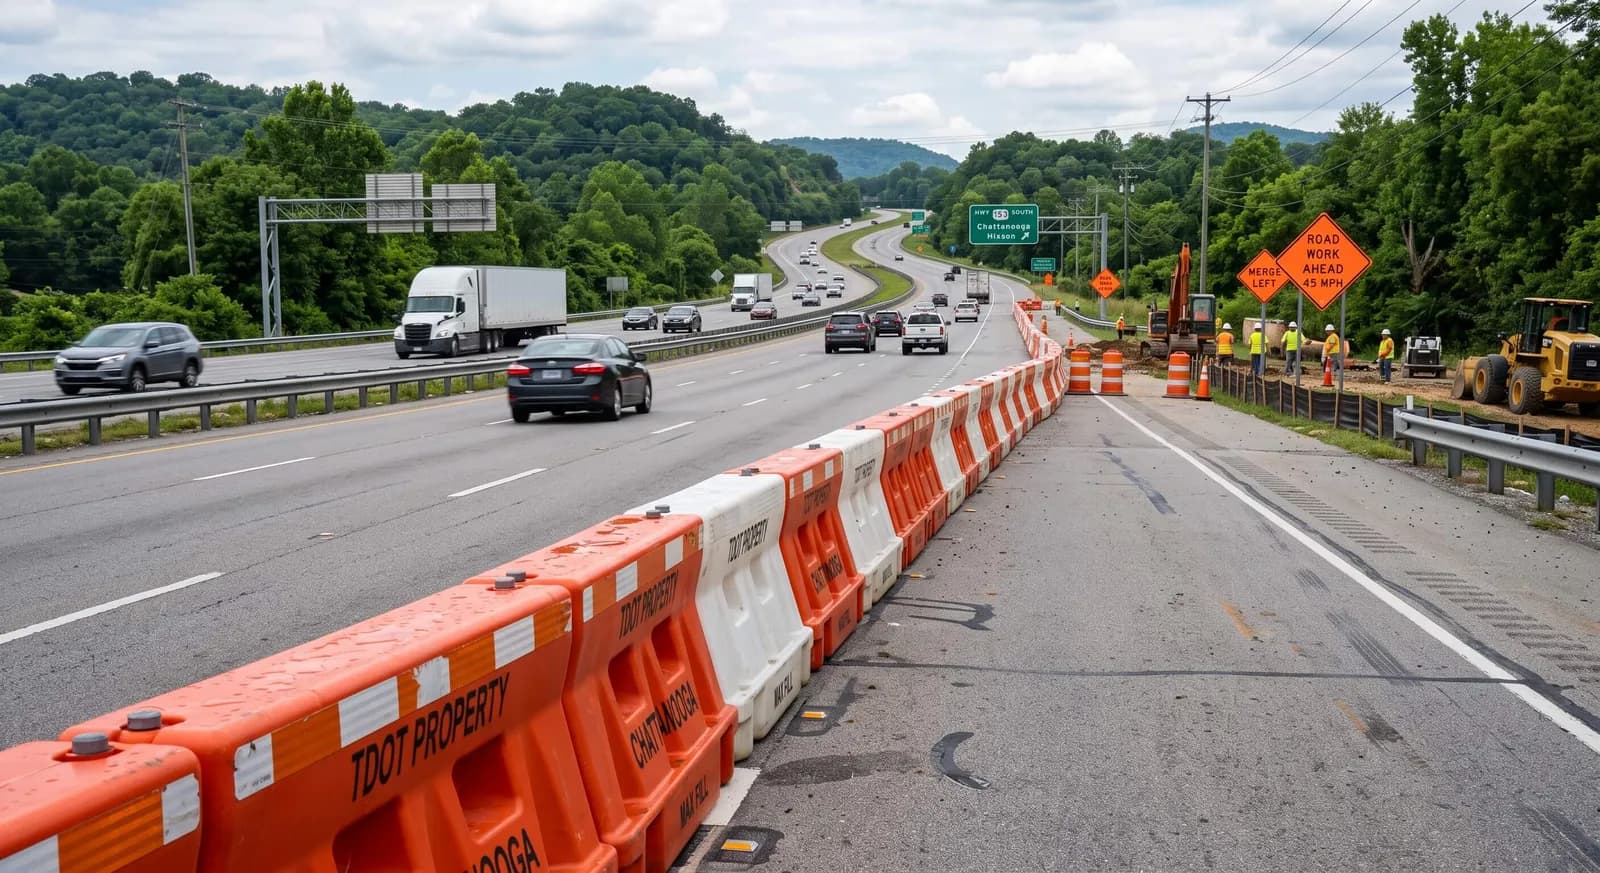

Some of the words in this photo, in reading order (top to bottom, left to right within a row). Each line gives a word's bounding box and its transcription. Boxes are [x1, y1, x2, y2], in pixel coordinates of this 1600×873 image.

[977, 223, 1031, 232] Chattanooga
[987, 232, 1016, 240] Hixson
[1307, 234, 1340, 244] ROAD
[1306, 249, 1340, 259] WORK
[1248, 268, 1281, 276] MERGE
[1303, 264, 1344, 274] AHEAD
[1252, 279, 1276, 288] LEFT
[1303, 278, 1317, 288] 45
[1320, 278, 1343, 288] MPH
[619, 593, 642, 641] TDOT
[640, 567, 679, 624] PROPERTY
[630, 680, 699, 769] CHATTANOOGA
[351, 726, 409, 802] TDOT
[411, 671, 510, 767] PROPERTY
[680, 788, 695, 829] MAX
[695, 774, 709, 809] FILL
